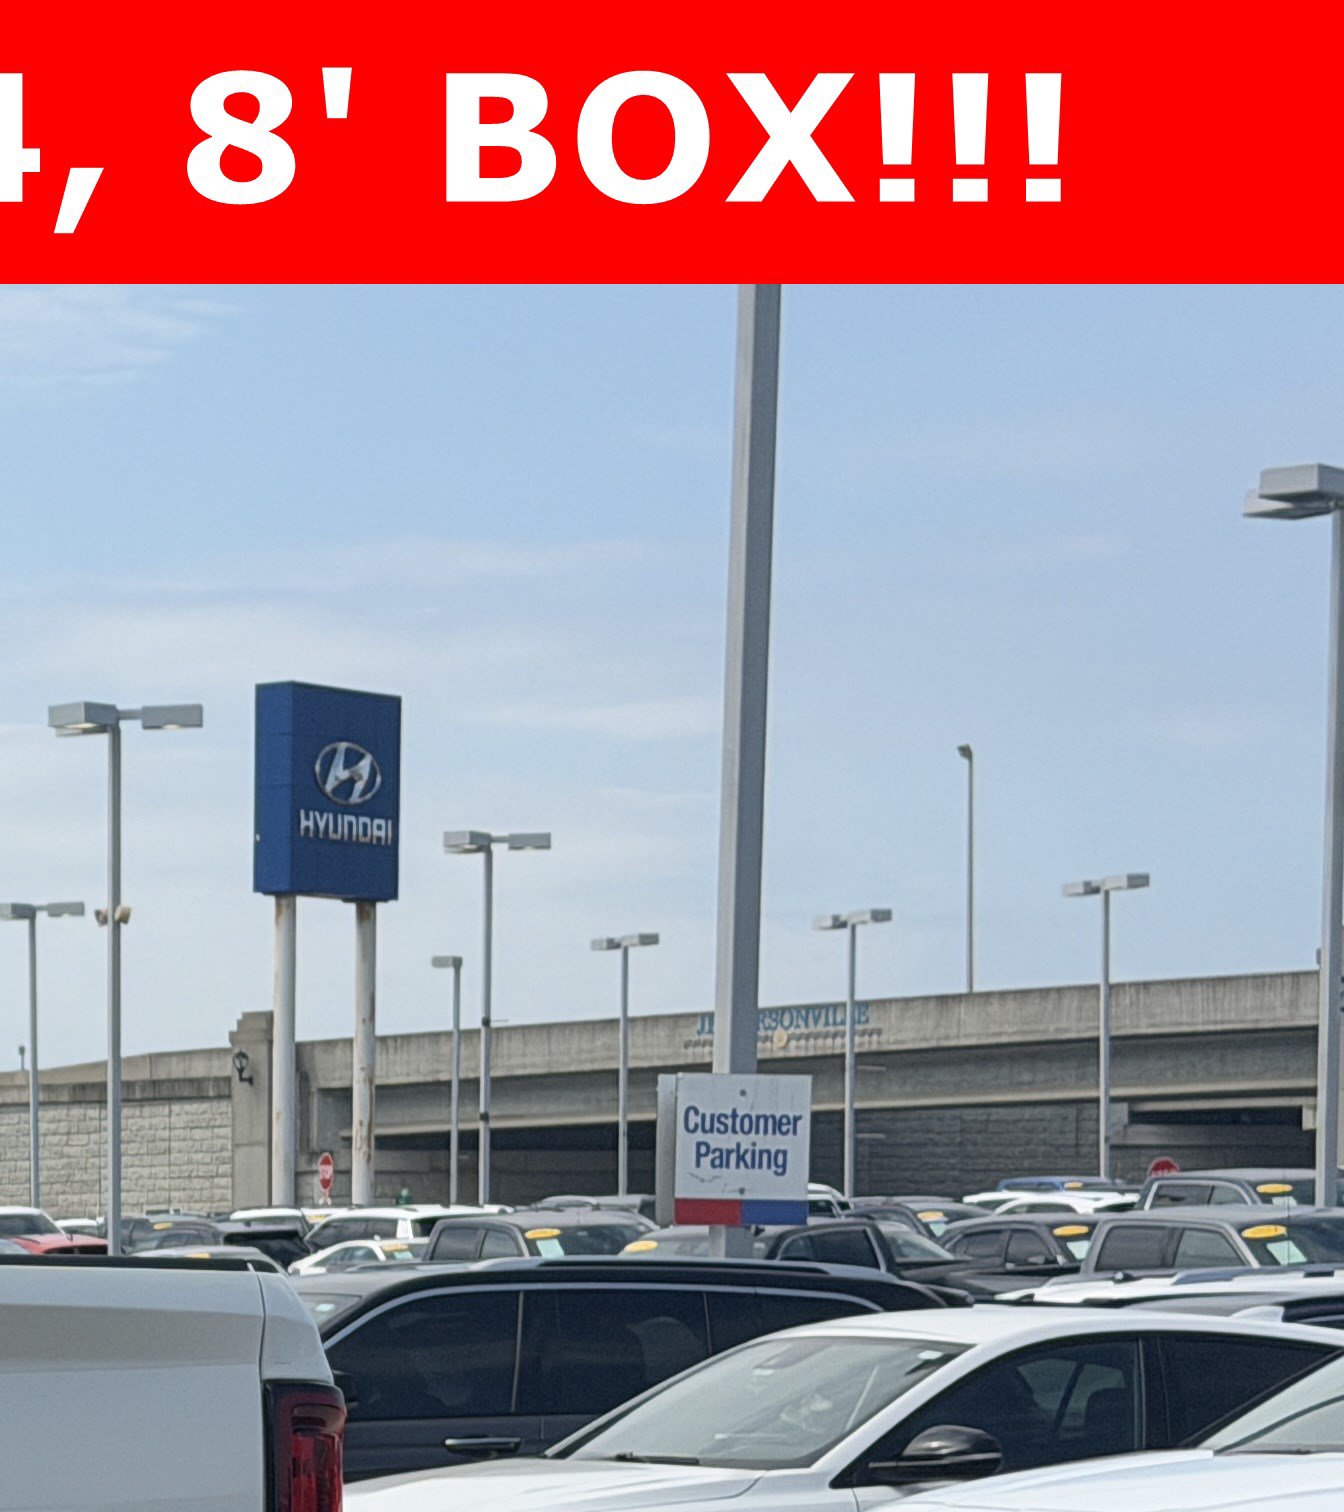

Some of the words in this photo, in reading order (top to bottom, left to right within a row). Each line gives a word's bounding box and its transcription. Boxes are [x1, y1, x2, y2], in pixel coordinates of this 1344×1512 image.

[299, 808, 392, 846] HYUNDAI
[683, 1105, 803, 1136] Customer
[694, 1141, 788, 1176] Parking
